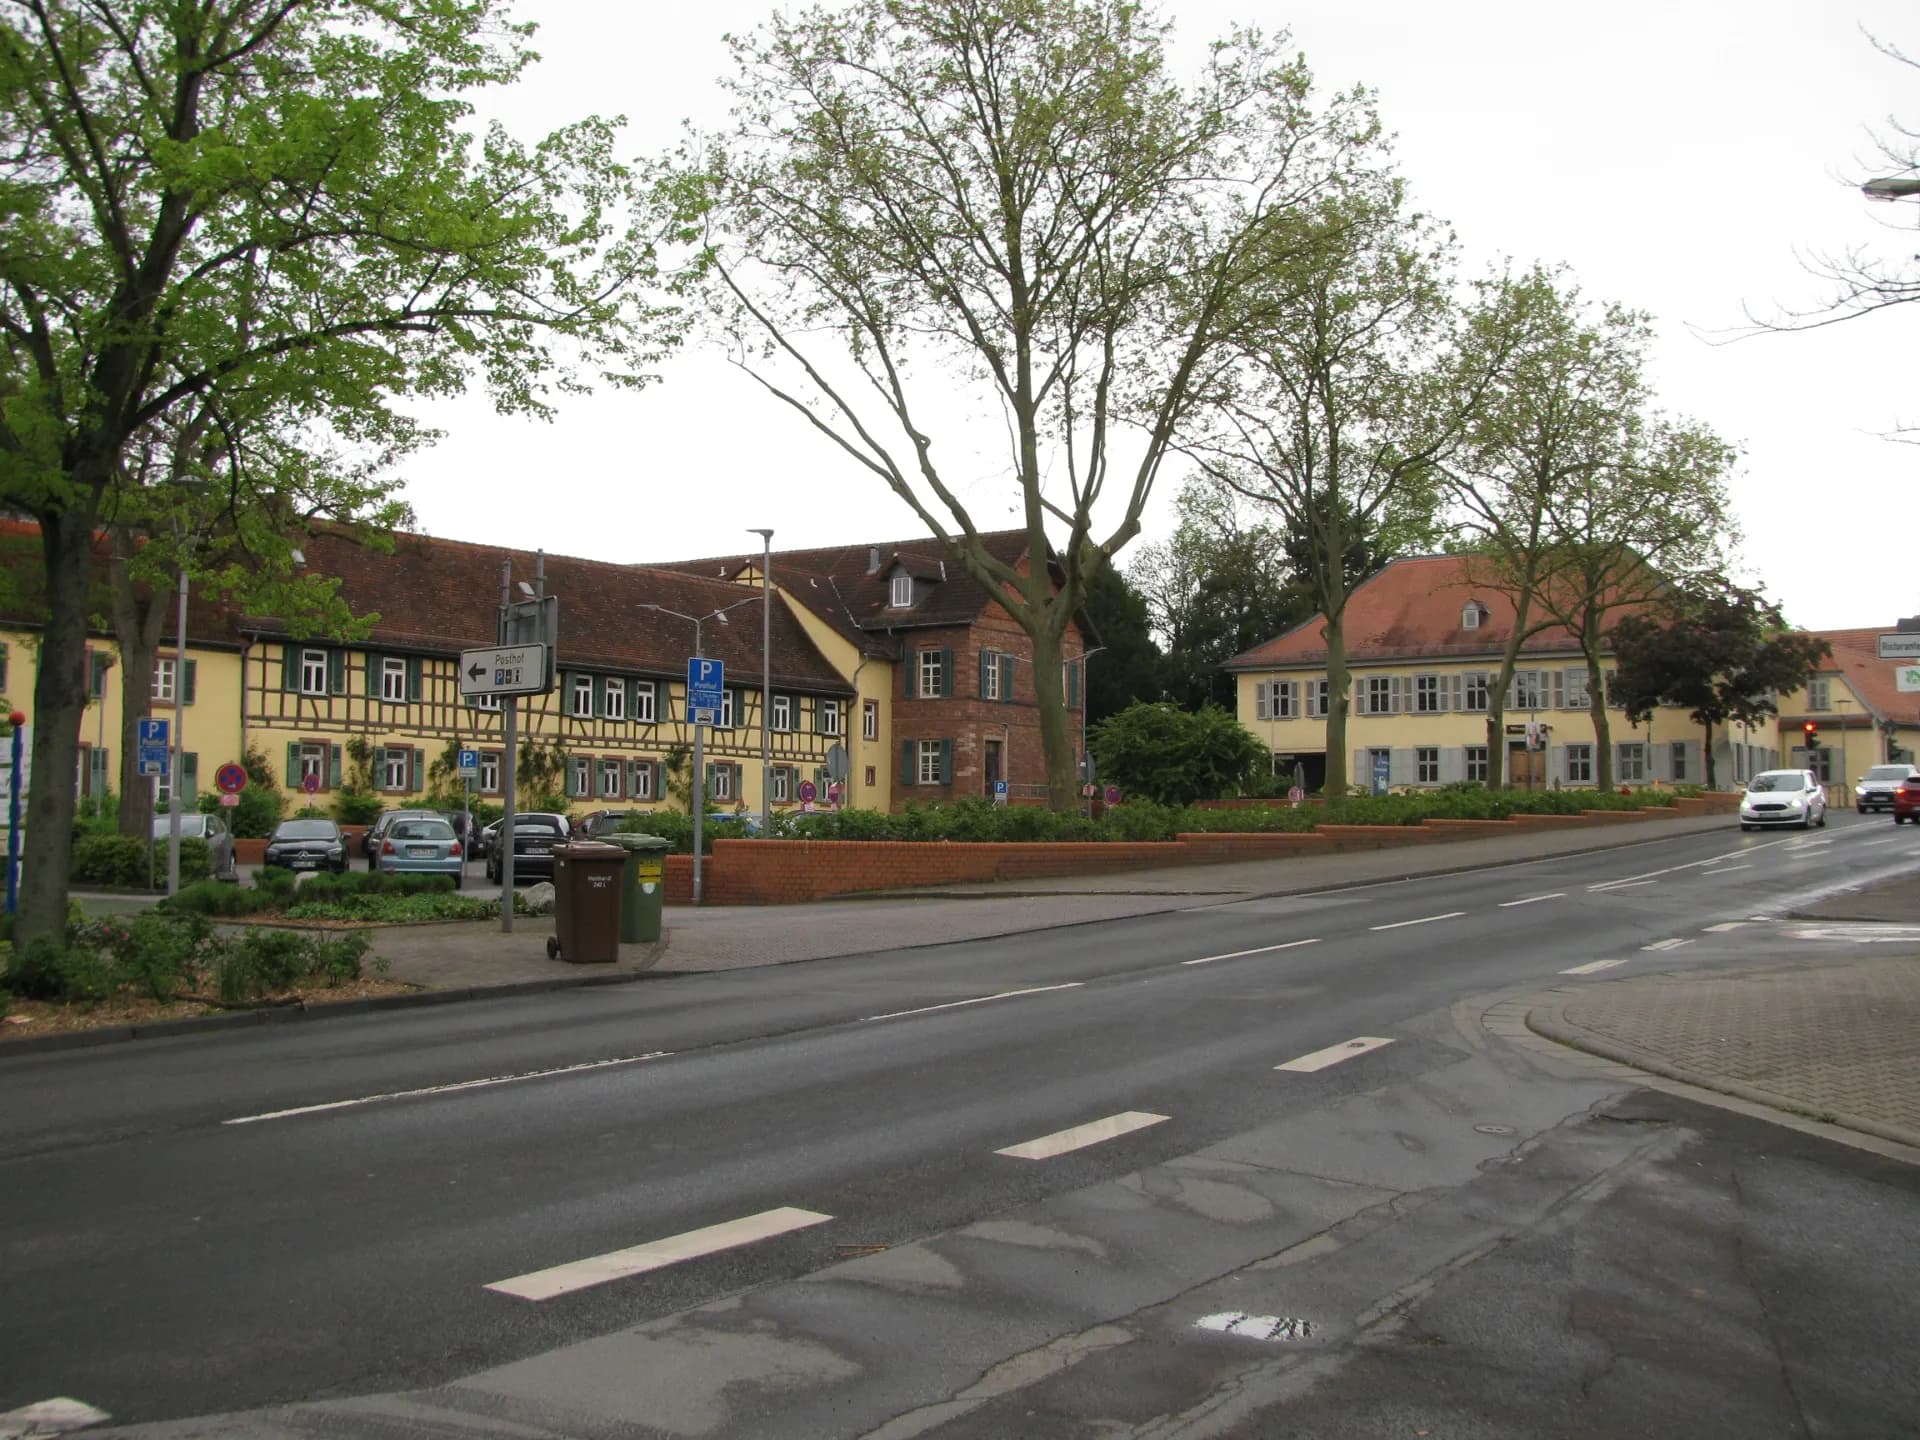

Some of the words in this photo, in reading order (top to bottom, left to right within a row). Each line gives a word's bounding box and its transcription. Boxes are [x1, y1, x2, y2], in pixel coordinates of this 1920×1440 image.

[495, 653, 525, 665] Posthof
[700, 661, 712, 681] P
[148, 721, 160, 739] P
[463, 751, 473, 767] P
[997, 782, 1004, 793] P
